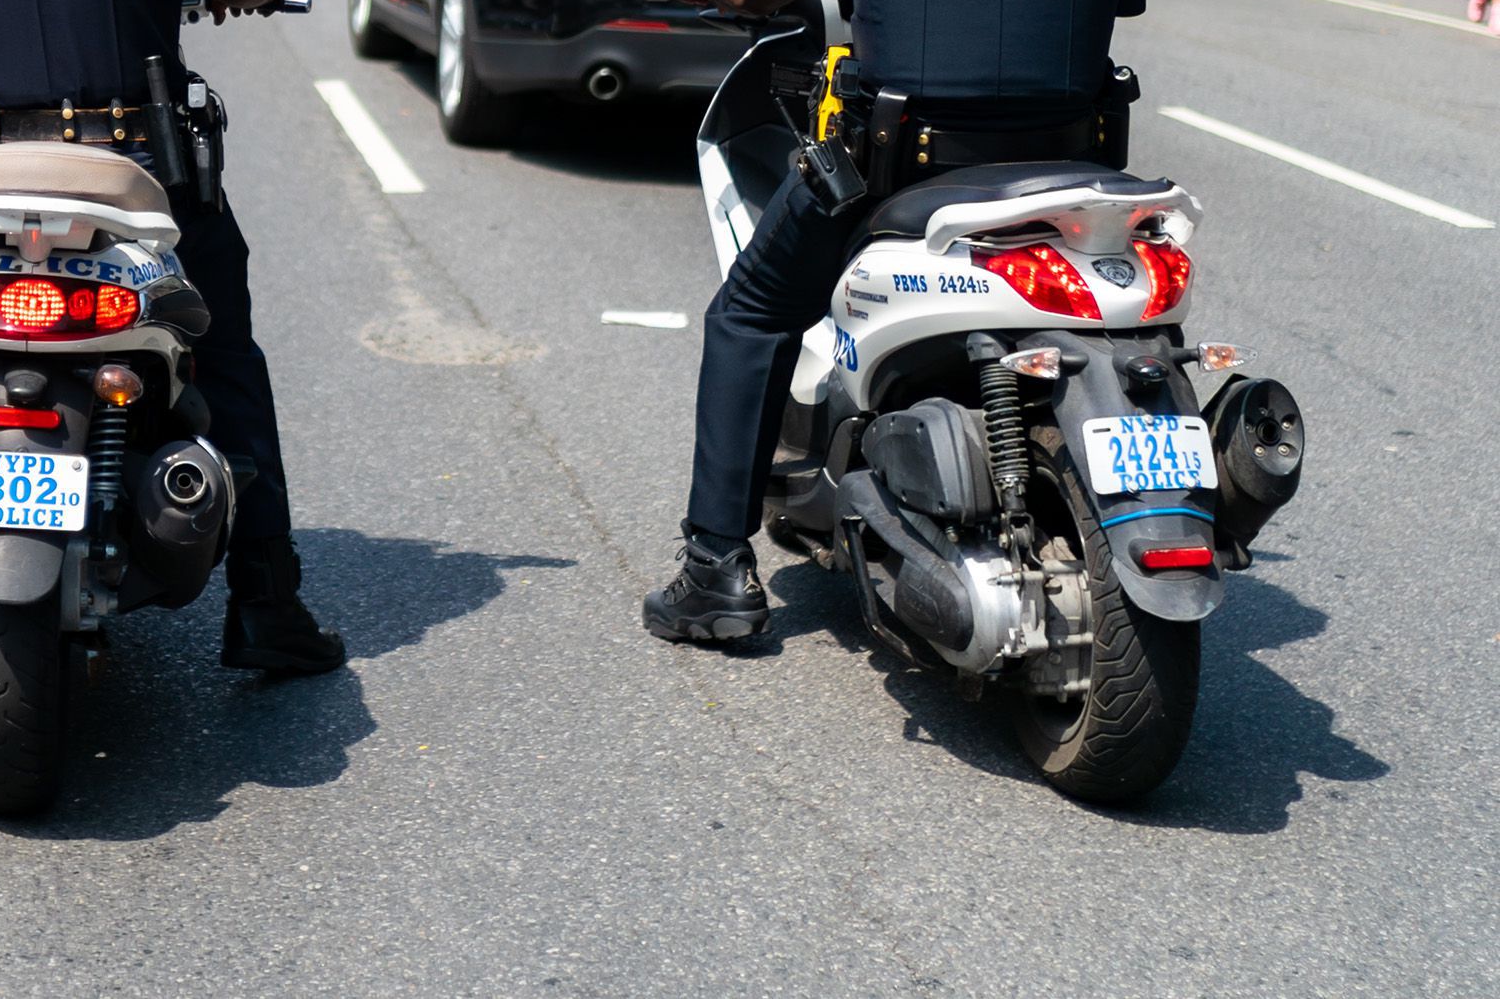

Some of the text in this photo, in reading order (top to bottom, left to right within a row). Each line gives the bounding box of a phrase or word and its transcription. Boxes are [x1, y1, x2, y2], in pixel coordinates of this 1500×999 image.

[892, 274, 928, 293] PBMS
[1120, 416, 1179, 434] NYPD
[1118, 470, 1203, 492] POLICE
